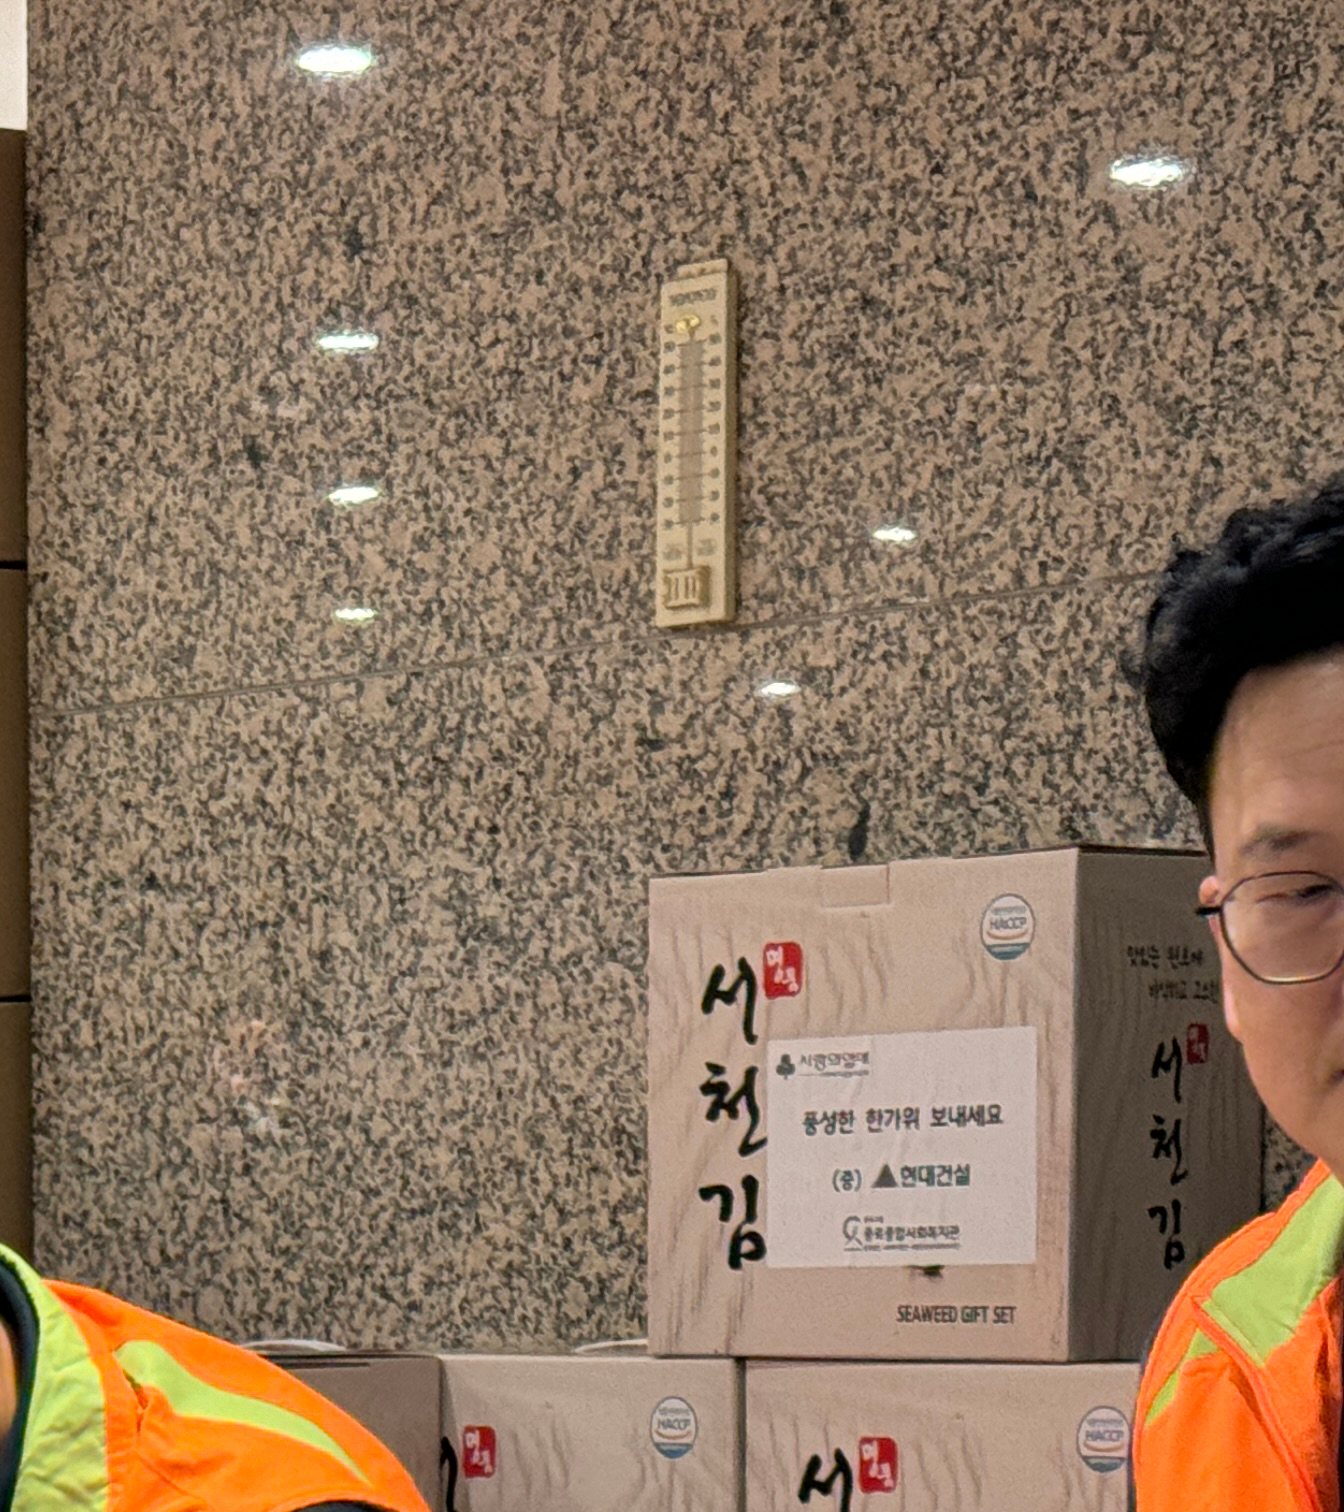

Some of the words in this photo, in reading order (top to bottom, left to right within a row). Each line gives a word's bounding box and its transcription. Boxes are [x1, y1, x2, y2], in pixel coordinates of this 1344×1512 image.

[698, 957, 769, 1269] 서천김
[802, 1109, 855, 1136] 풍성한
[866, 1106, 920, 1133] 한가위
[931, 1104, 1004, 1128] 보내세요
[1148, 1036, 1189, 1270] 서천김
[900, 1164, 970, 1188] 현대건설
[897, 1305, 958, 1323] SEAWEED
[961, 1305, 989, 1323] GIFT
[993, 1306, 1017, 1324] SET
